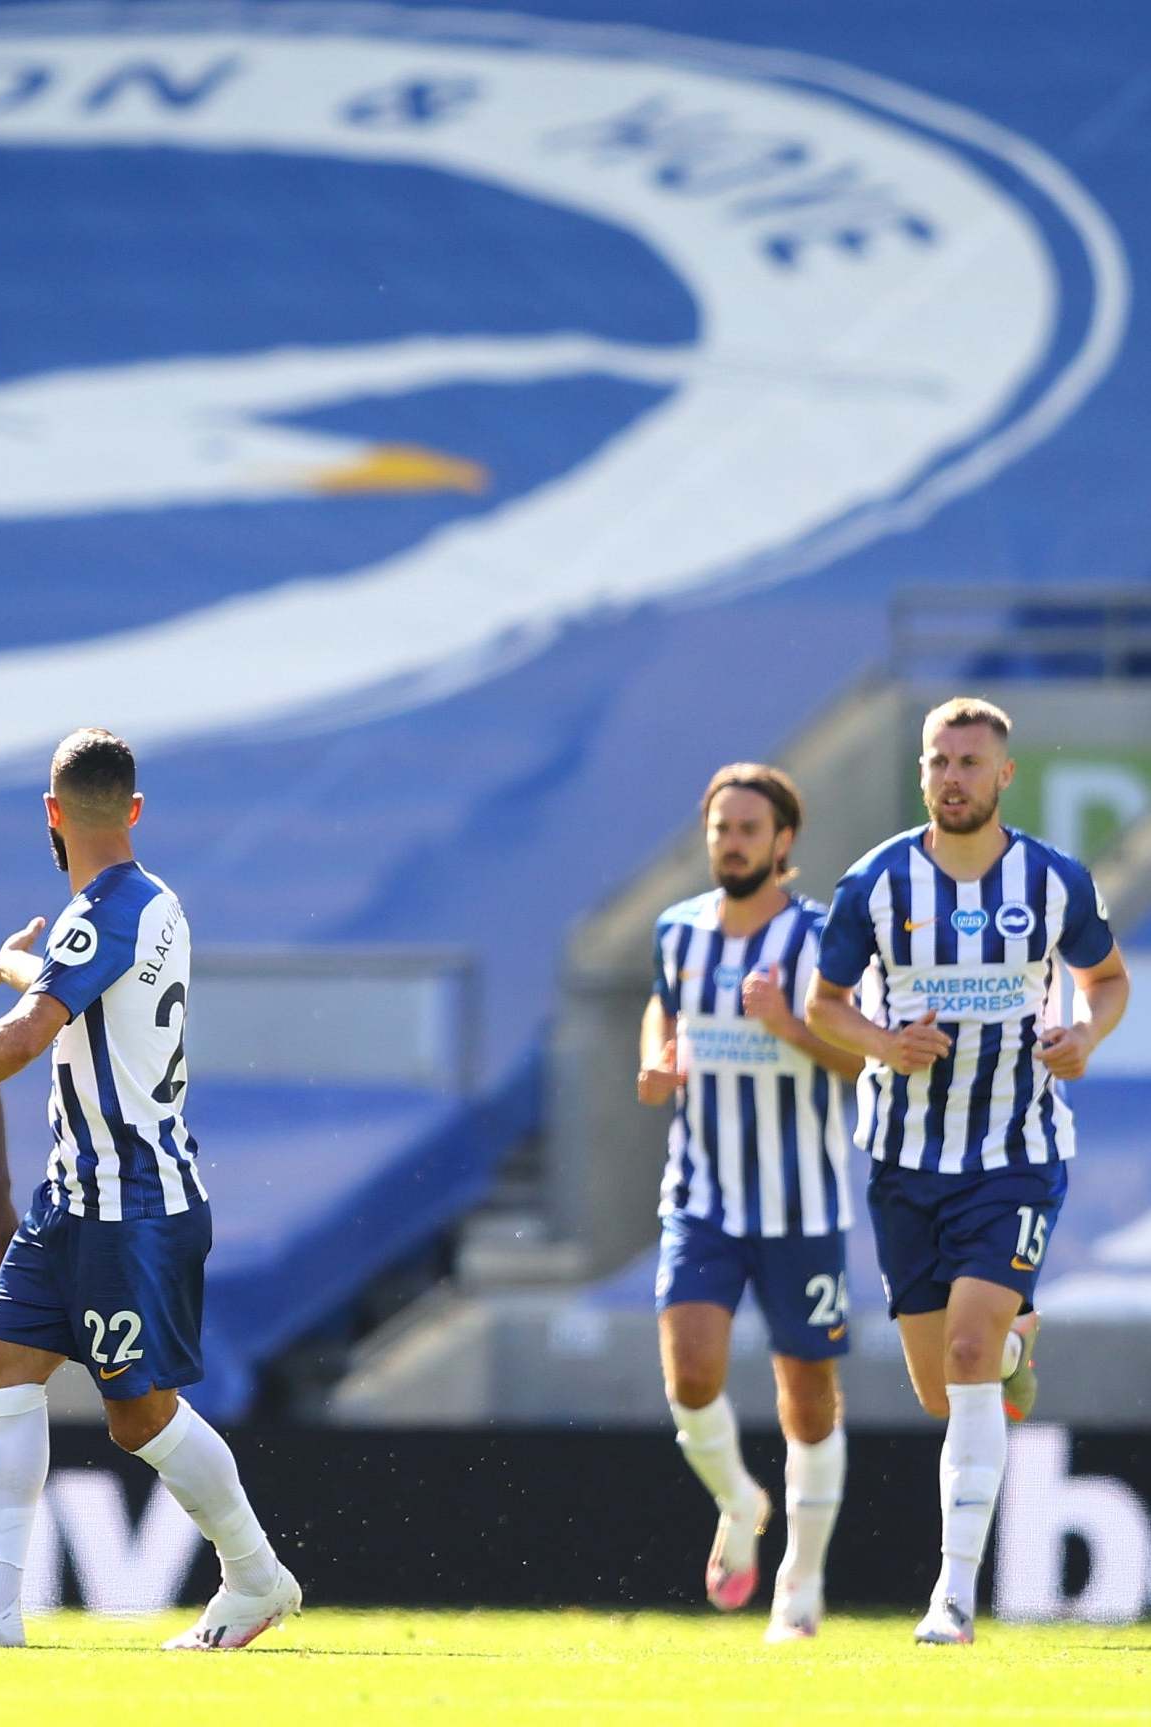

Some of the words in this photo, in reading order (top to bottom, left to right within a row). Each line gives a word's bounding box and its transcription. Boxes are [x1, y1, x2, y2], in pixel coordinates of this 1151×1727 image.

[56, 927, 92, 954] JD
[912, 975, 1026, 993] AMERICAN
[927, 991, 1026, 1012] EXPRESS
[1015, 1206, 1048, 1266] 15
[805, 1272, 849, 1326] 24
[84, 1309, 144, 1365] 22
